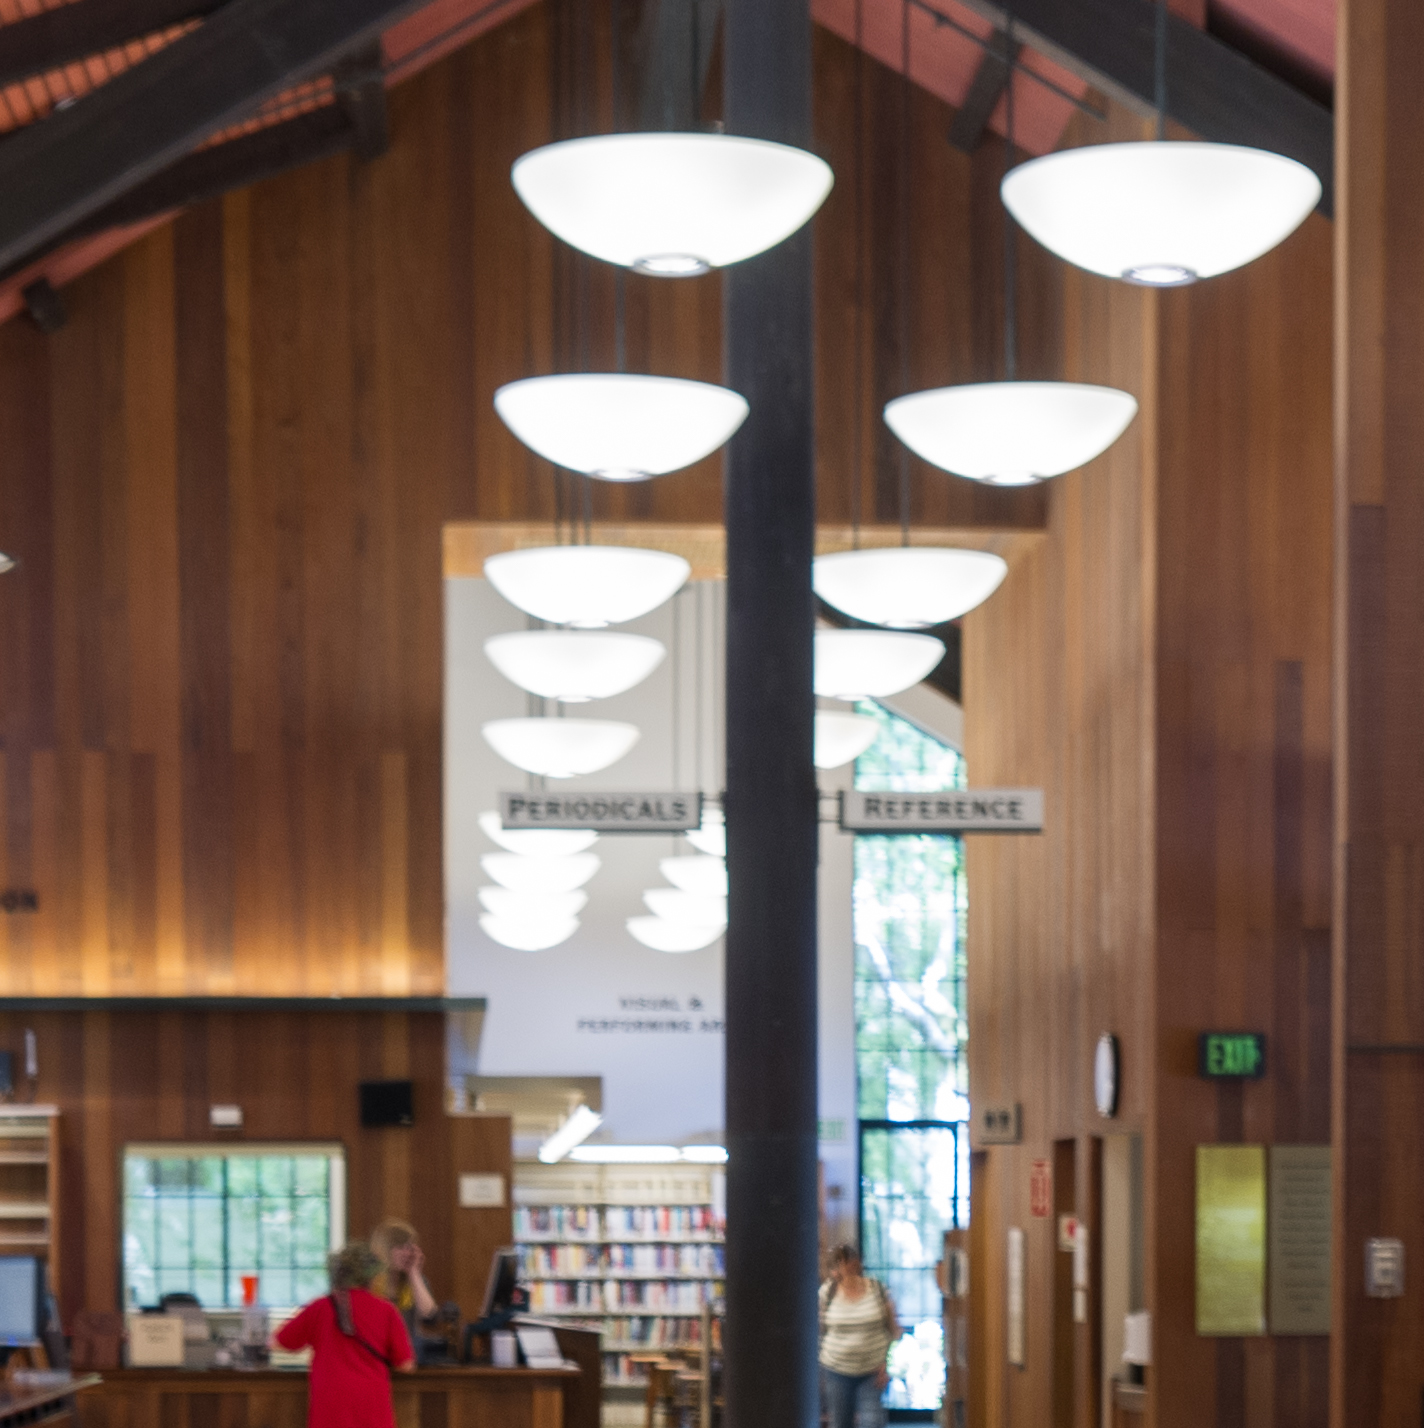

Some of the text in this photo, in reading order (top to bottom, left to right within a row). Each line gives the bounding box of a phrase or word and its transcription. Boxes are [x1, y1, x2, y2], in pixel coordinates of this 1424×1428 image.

[509, 799, 687, 821] PERIODICALS
[864, 798, 1023, 820] REFERENCE
[577, 1019, 692, 1034] PERFORMING
[1207, 1035, 1256, 1074] EXIT
